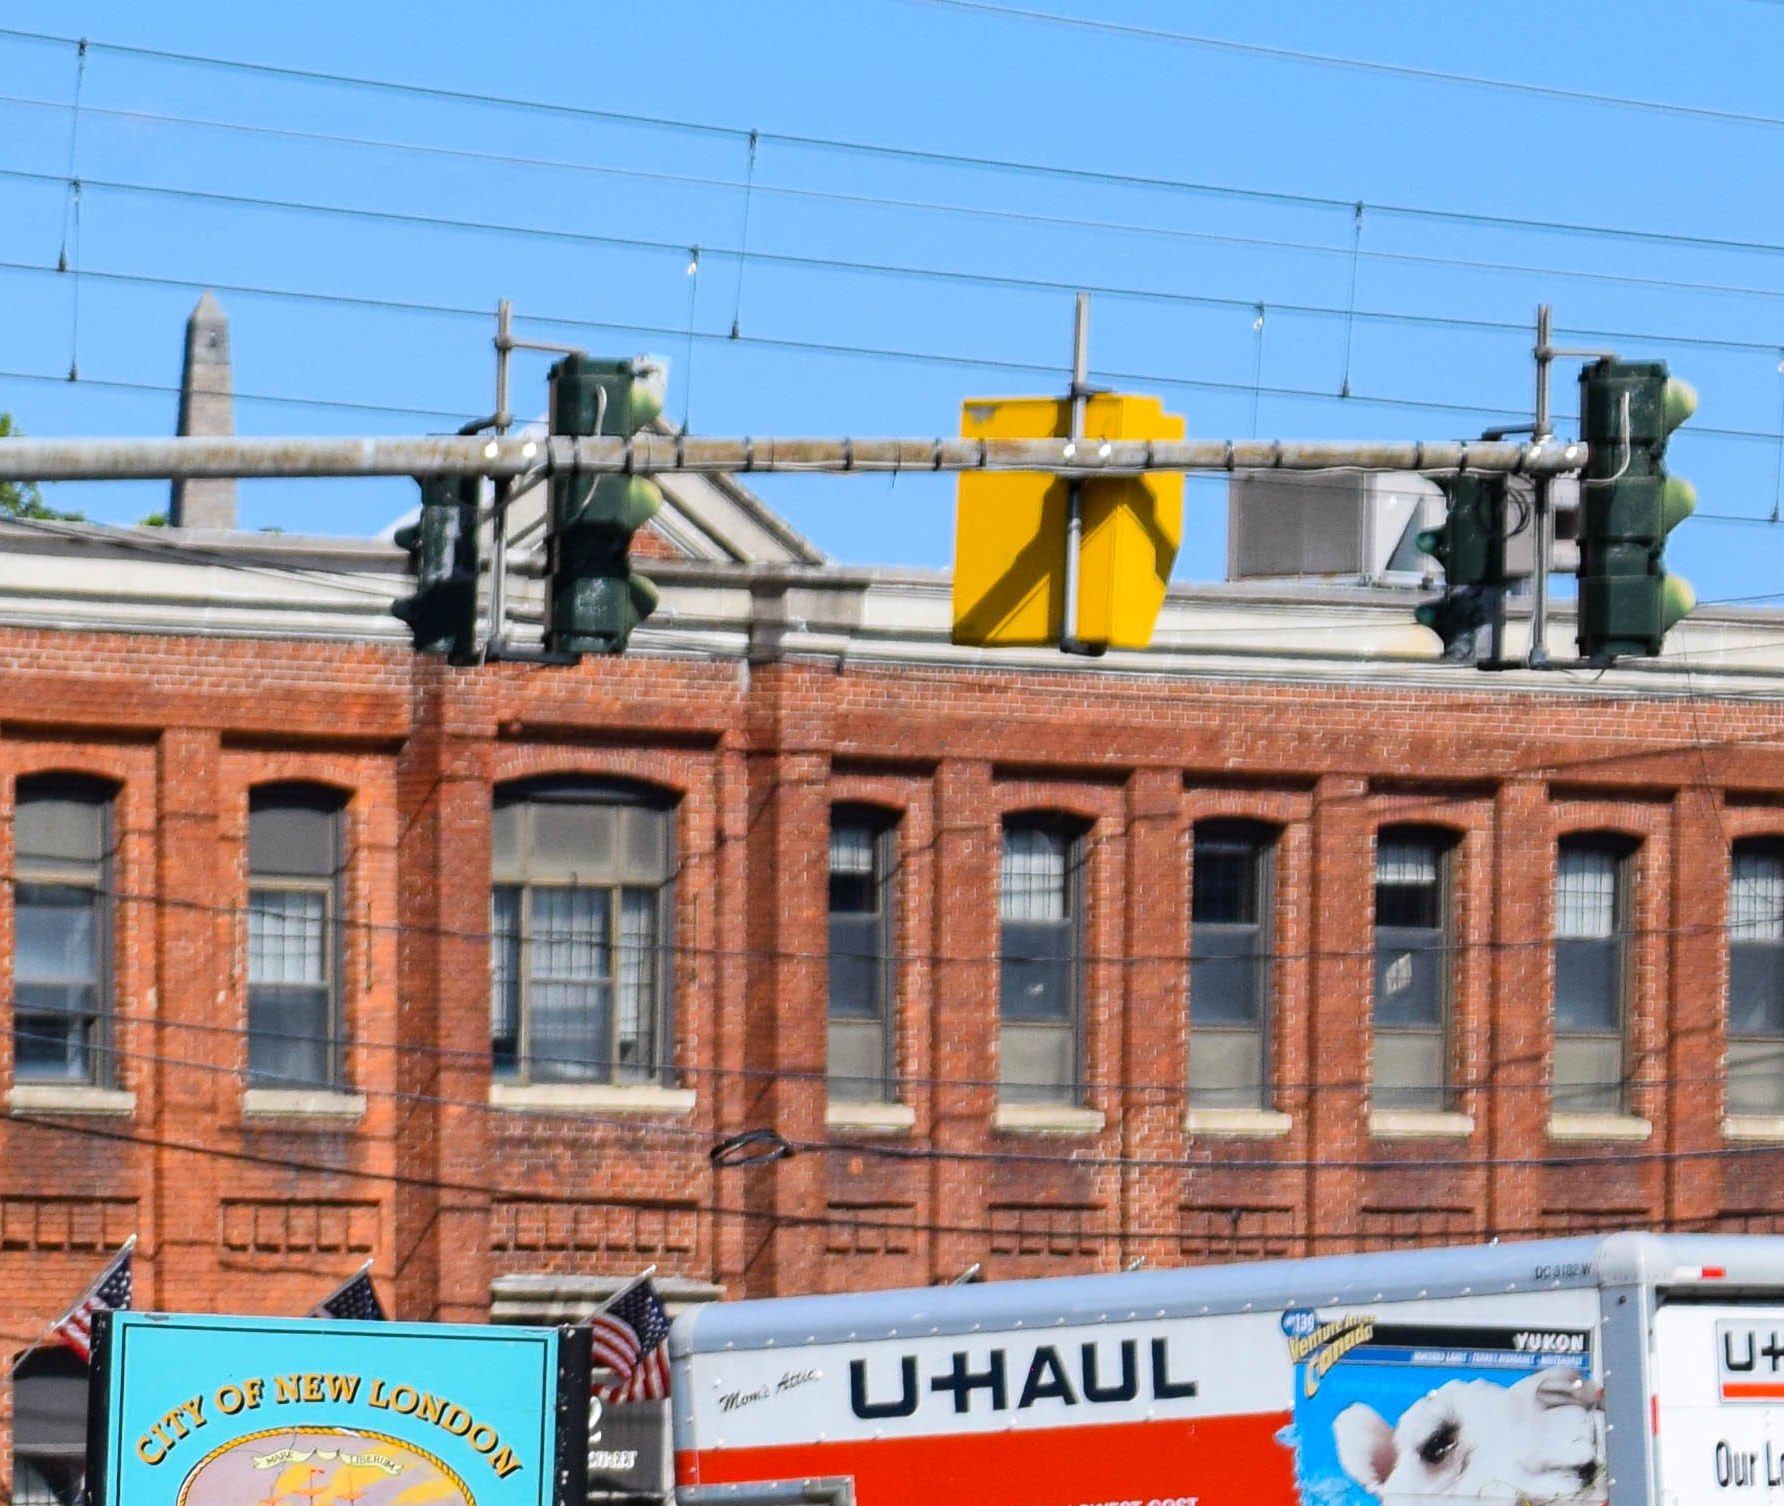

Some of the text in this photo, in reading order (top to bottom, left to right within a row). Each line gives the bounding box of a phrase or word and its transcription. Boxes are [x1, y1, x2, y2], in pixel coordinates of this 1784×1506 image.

[1516, 1331, 1585, 1354] YUKON
[136, 1372, 523, 1479] CITY OF NEW LONDON
[1715, 1439, 1759, 1488] Our
